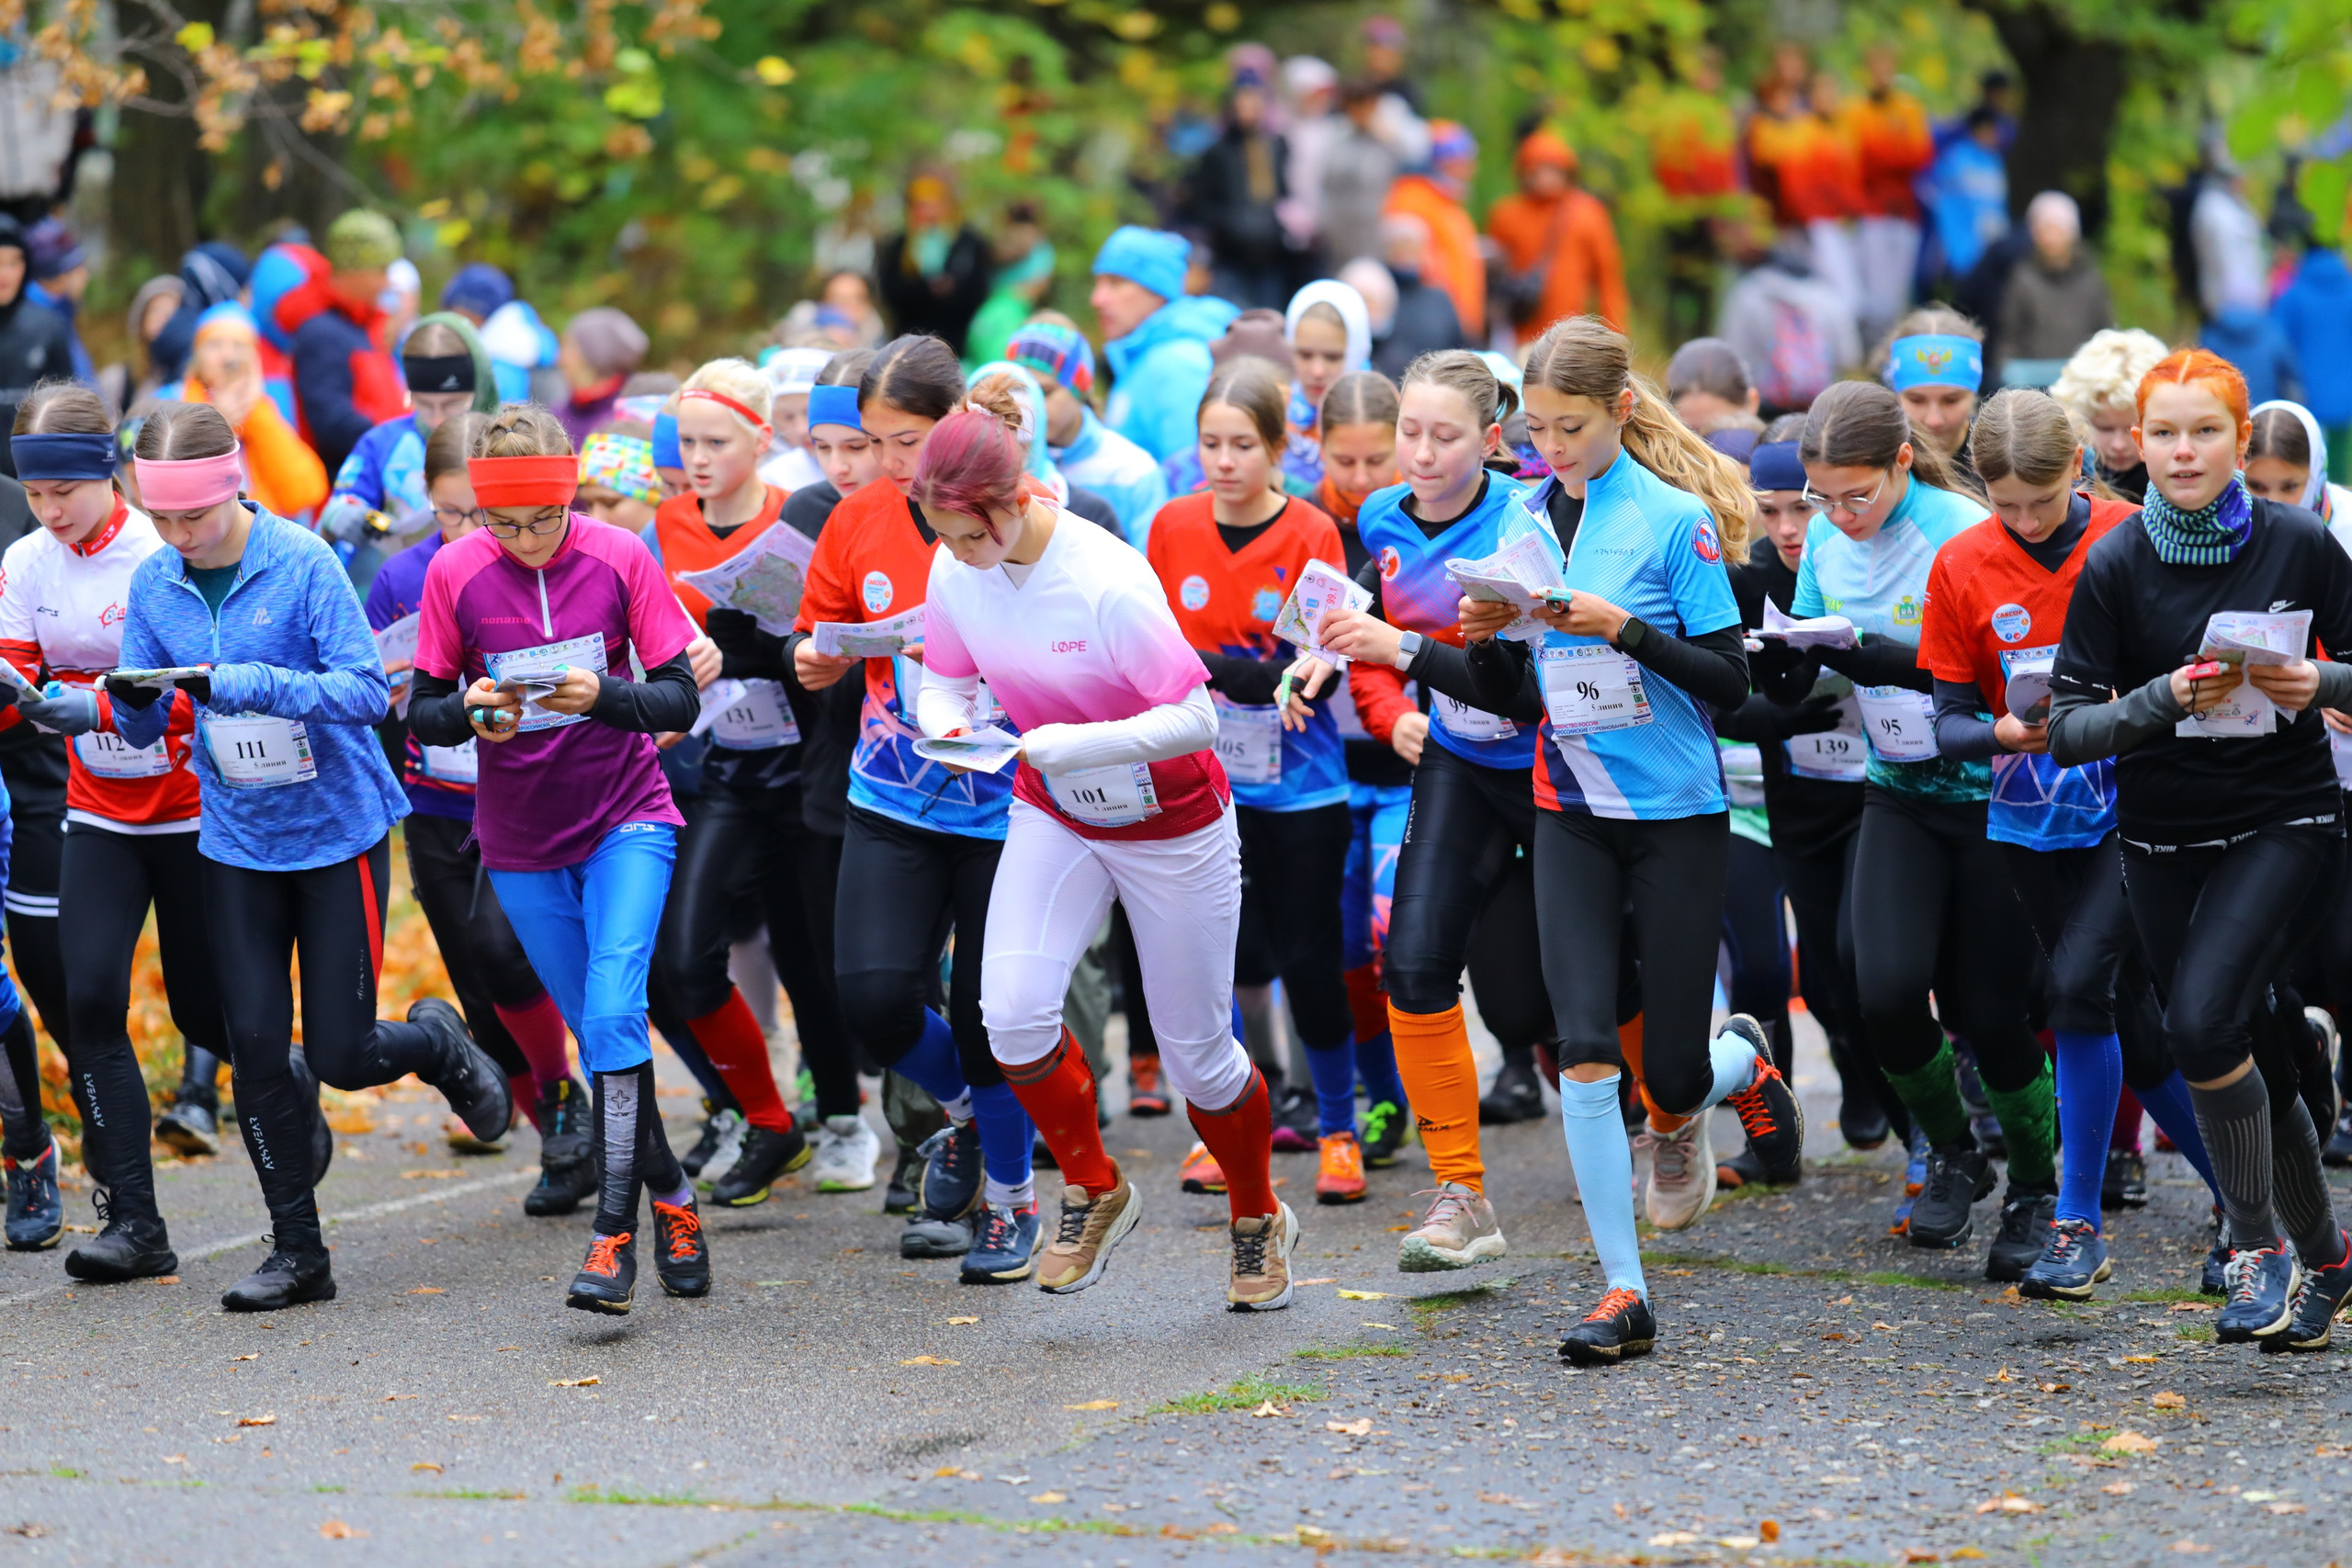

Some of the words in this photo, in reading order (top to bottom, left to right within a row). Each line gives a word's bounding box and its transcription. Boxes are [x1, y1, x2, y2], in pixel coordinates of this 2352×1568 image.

[1326, 587, 1338, 605] 99.1
[481, 616, 531, 625] noname
[1996, 610, 2023, 619] САКСОР
[1577, 681, 1600, 701] 96
[1449, 697, 1468, 715] 99
[1597, 703, 1623, 711] линия
[726, 707, 754, 724] 131
[1881, 718, 1902, 736] 95
[96, 735, 126, 751] 112
[236, 739, 266, 760] 111
[1215, 736, 1245, 759] 105
[1815, 739, 1849, 754] 139
[260, 761, 287, 769] линия
[1071, 787, 1108, 804] 101
[1102, 804, 1128, 812] линия
[249, 1116, 275, 1170] ARSWEAR
